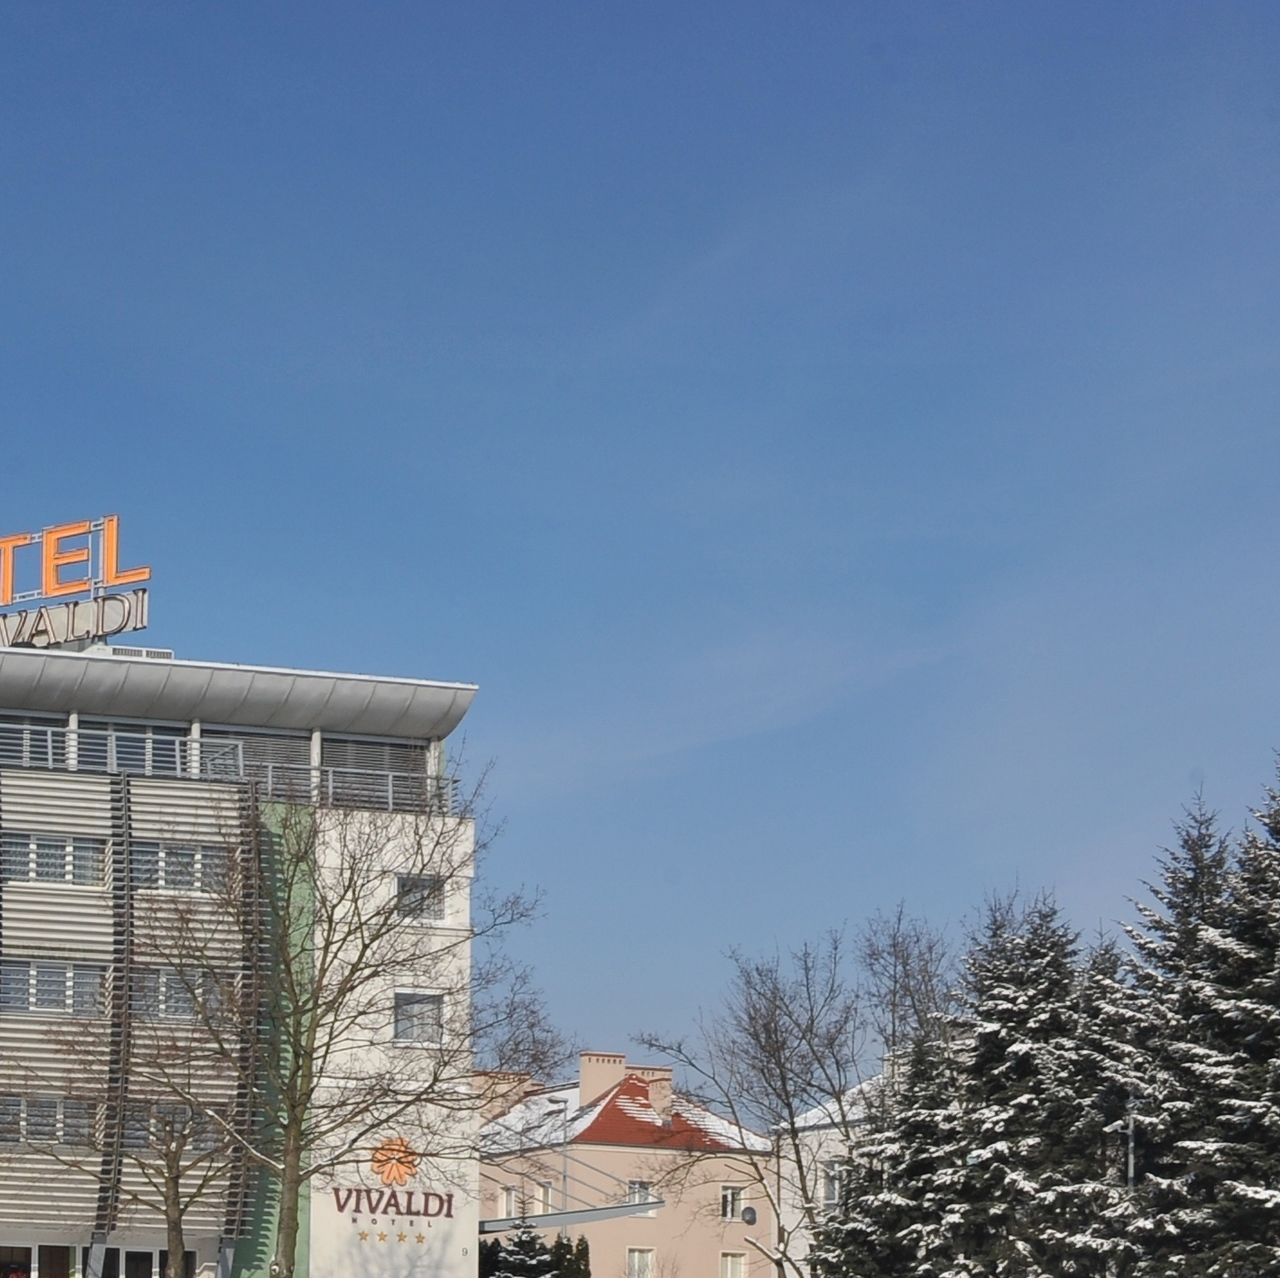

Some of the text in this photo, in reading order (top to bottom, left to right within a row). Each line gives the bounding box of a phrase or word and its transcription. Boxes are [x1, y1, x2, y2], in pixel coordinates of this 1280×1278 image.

[333, 1187, 453, 1219] VIVALDI
[352, 1218, 432, 1229] HOTEL
[462, 1248, 469, 1257] 9
